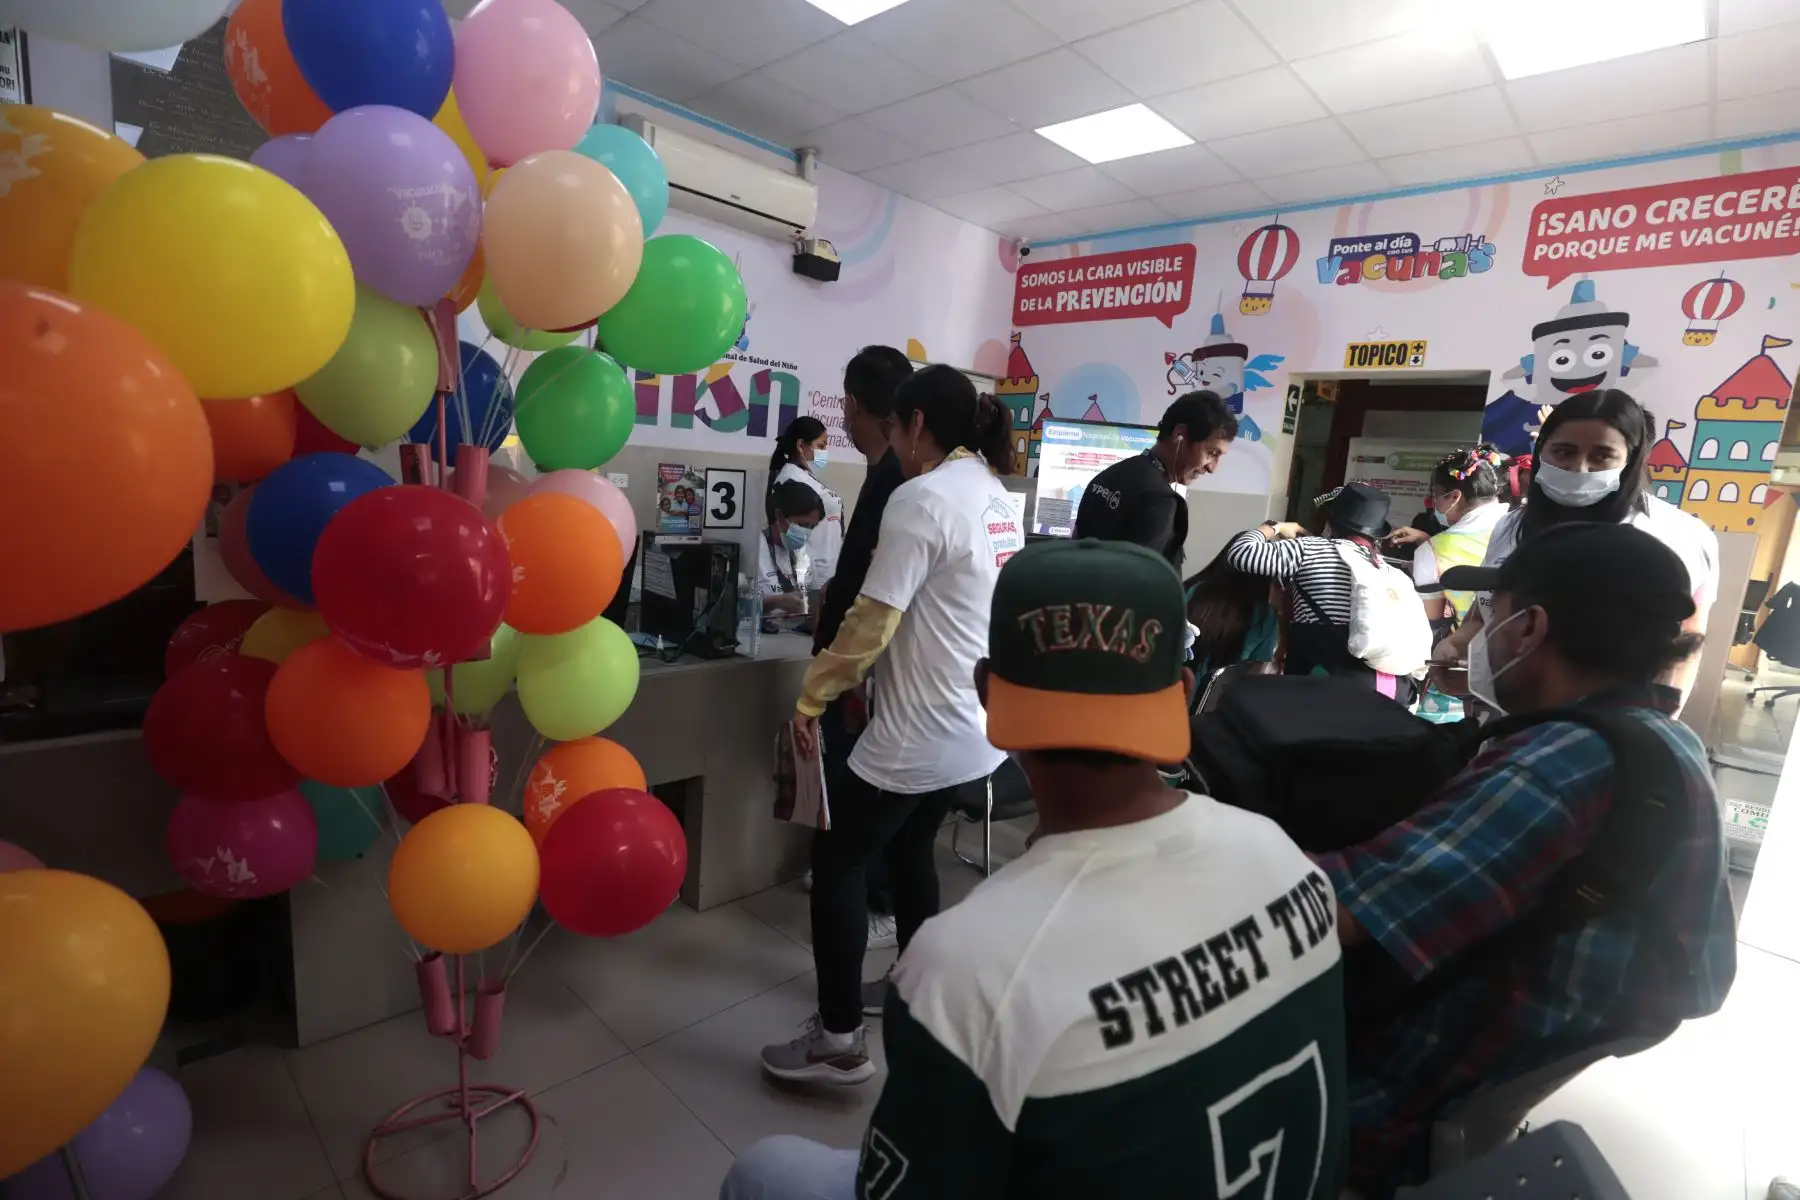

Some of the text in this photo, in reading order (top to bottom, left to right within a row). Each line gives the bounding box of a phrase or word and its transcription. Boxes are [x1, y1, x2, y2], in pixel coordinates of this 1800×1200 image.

[1537, 204, 1637, 237] ¡SANO
[1333, 234, 1413, 256] Ponte al día
[1533, 235, 1630, 261] PORQUE
[1635, 231, 1673, 252] ME
[1021, 256, 1183, 288] SOMOS LA CARA VISIBLE
[1020, 276, 1183, 312] DE LA PREVENCIÓN
[739, 354, 747, 362] de
[748, 356, 769, 366] Salud
[770, 360, 780, 368] del
[781, 361, 798, 371] Niño
[1349, 343, 1408, 366] TOPICO
[710, 481, 737, 521] 3
[1017, 602, 1163, 665] TEXAS
[1089, 914, 1269, 1050] STREET
[1206, 1040, 1328, 1200] 7
